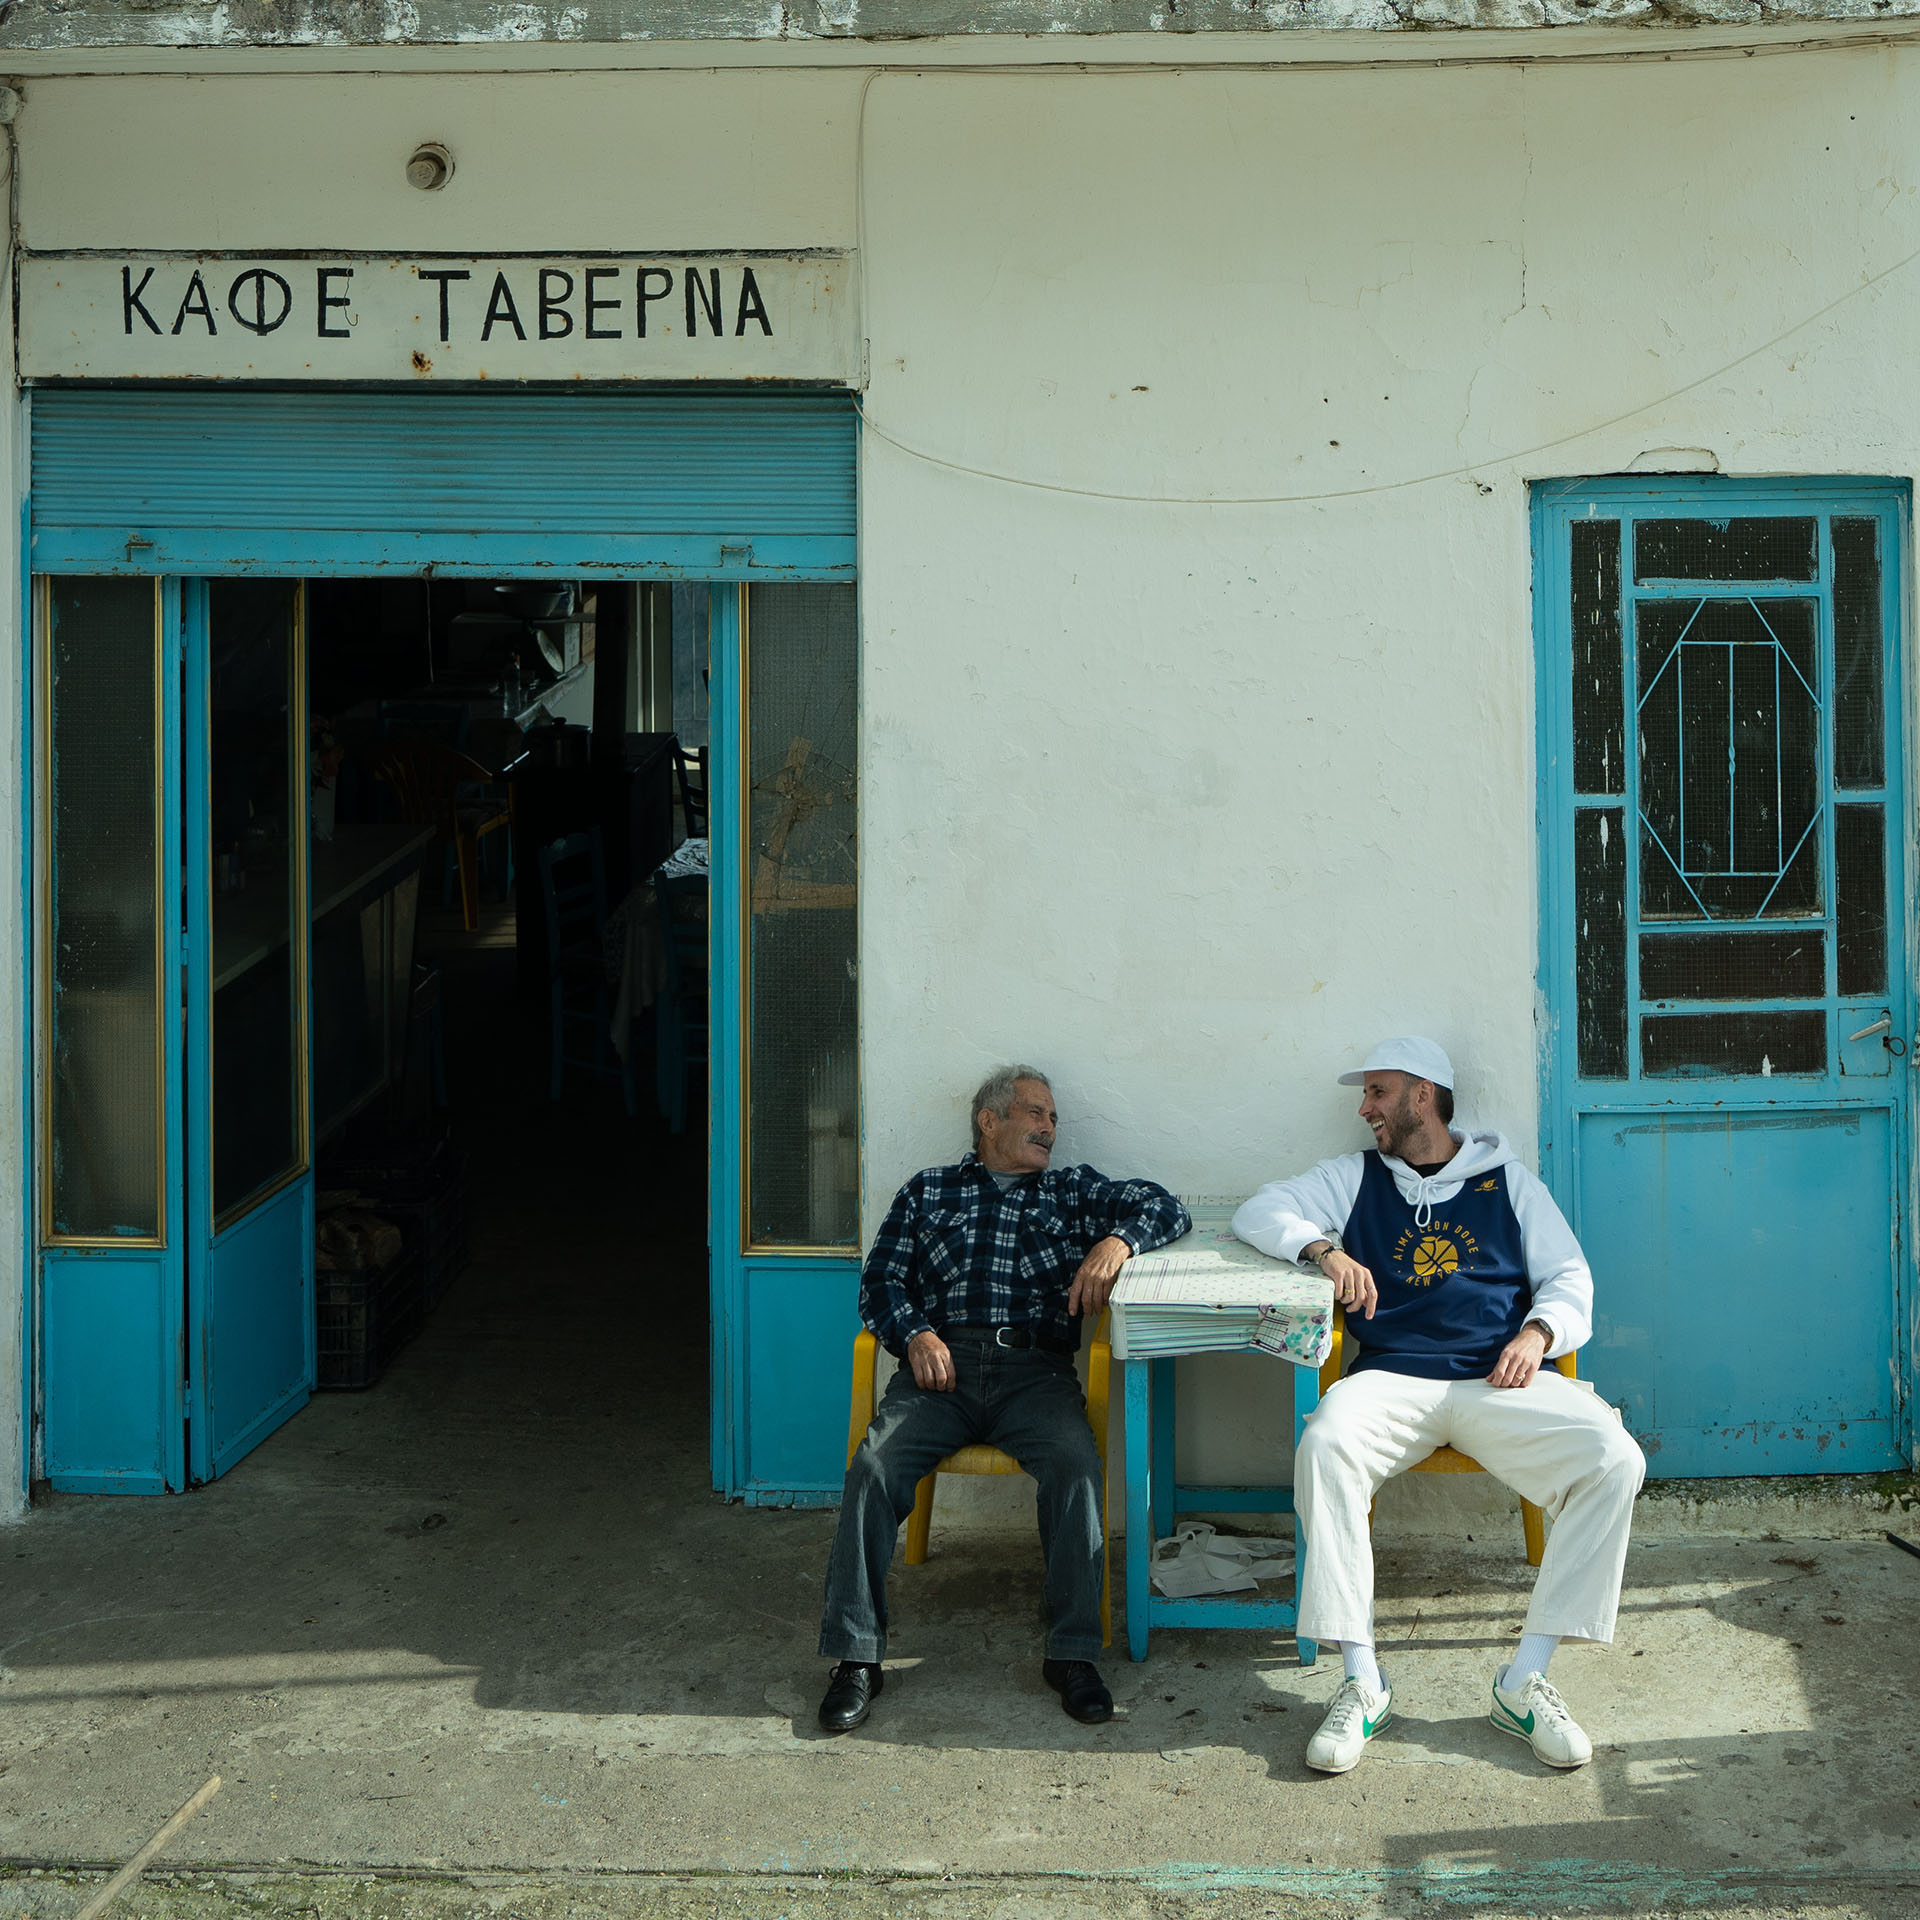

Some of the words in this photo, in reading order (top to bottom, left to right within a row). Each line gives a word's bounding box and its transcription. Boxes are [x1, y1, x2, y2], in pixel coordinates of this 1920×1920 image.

[121, 265, 352, 338] ΚΑΦΕ
[417, 267, 774, 342] ΤΑΒΕΡΝΑ
[1393, 1228, 1414, 1261] AIME
[1454, 1224, 1479, 1254] DORE
[1405, 1275, 1431, 1287] NEW
